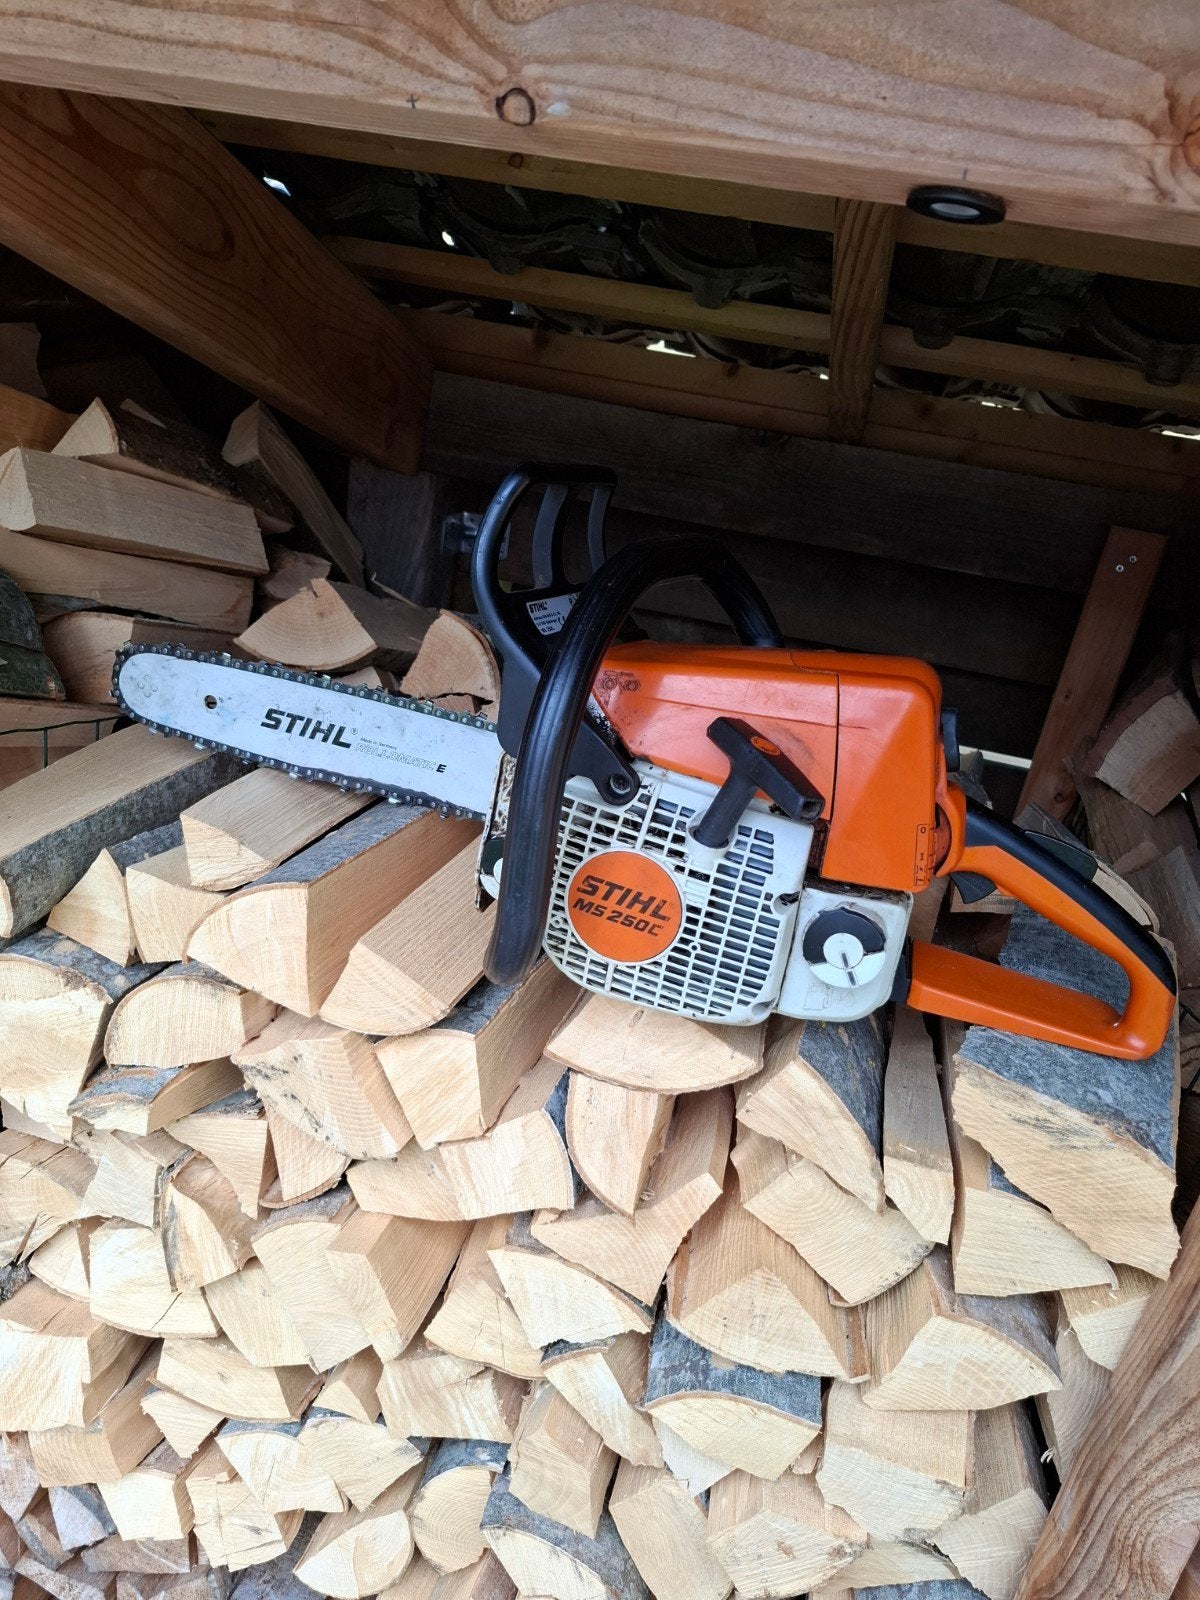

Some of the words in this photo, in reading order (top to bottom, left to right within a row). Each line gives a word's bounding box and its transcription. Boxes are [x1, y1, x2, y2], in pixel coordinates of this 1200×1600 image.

[529, 601, 547, 613] STIHL
[260, 708, 352, 749] STIHL
[354, 742, 437, 771] ROLLOMATIC
[436, 764, 447, 773] E
[573, 897, 607, 917] MS
[577, 874, 671, 922] STIHL
